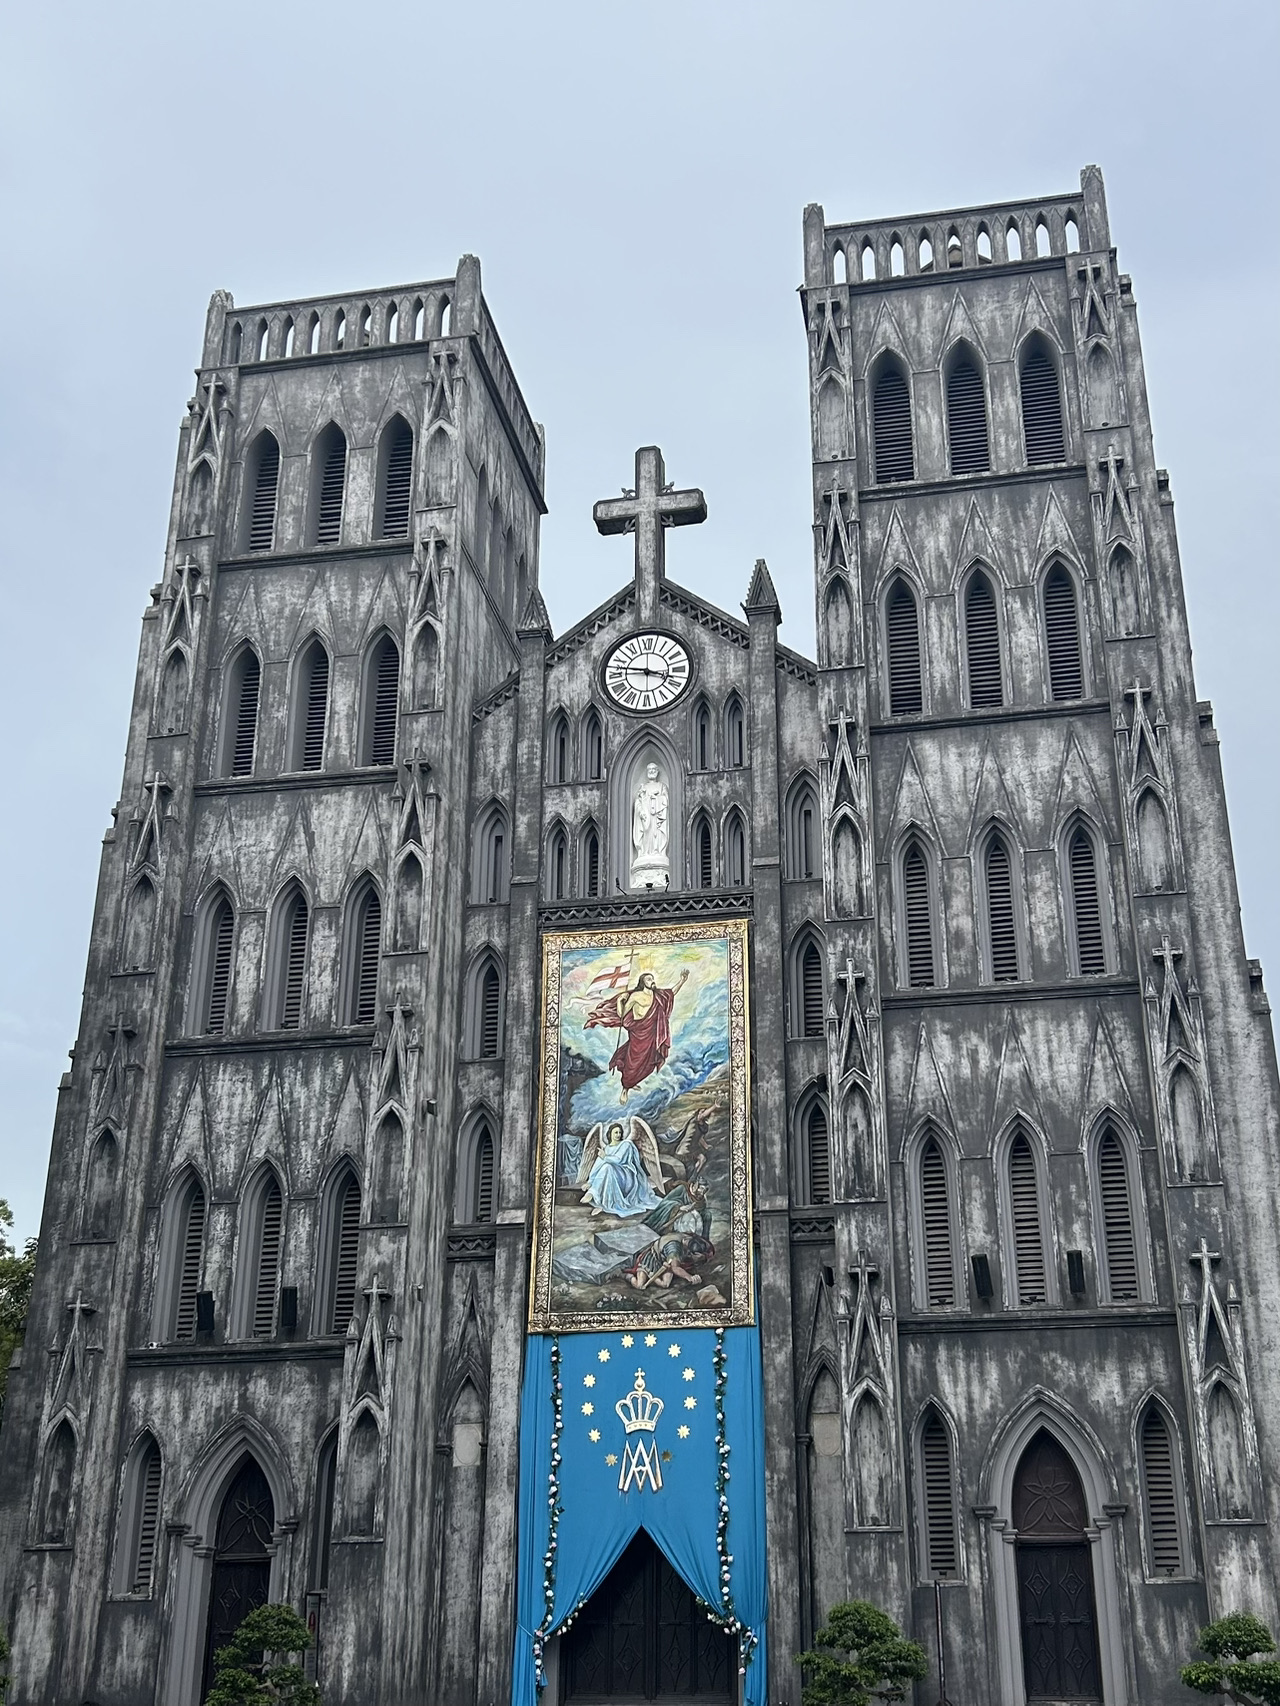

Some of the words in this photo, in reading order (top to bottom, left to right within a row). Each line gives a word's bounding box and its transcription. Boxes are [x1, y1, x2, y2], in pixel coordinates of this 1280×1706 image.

[625, 642, 638, 656] XI
[642, 638, 653, 651] XII
[659, 641, 667, 652] I
[613, 655, 627, 665] X
[642, 694, 651, 707] VI
[659, 690, 668, 701] V
